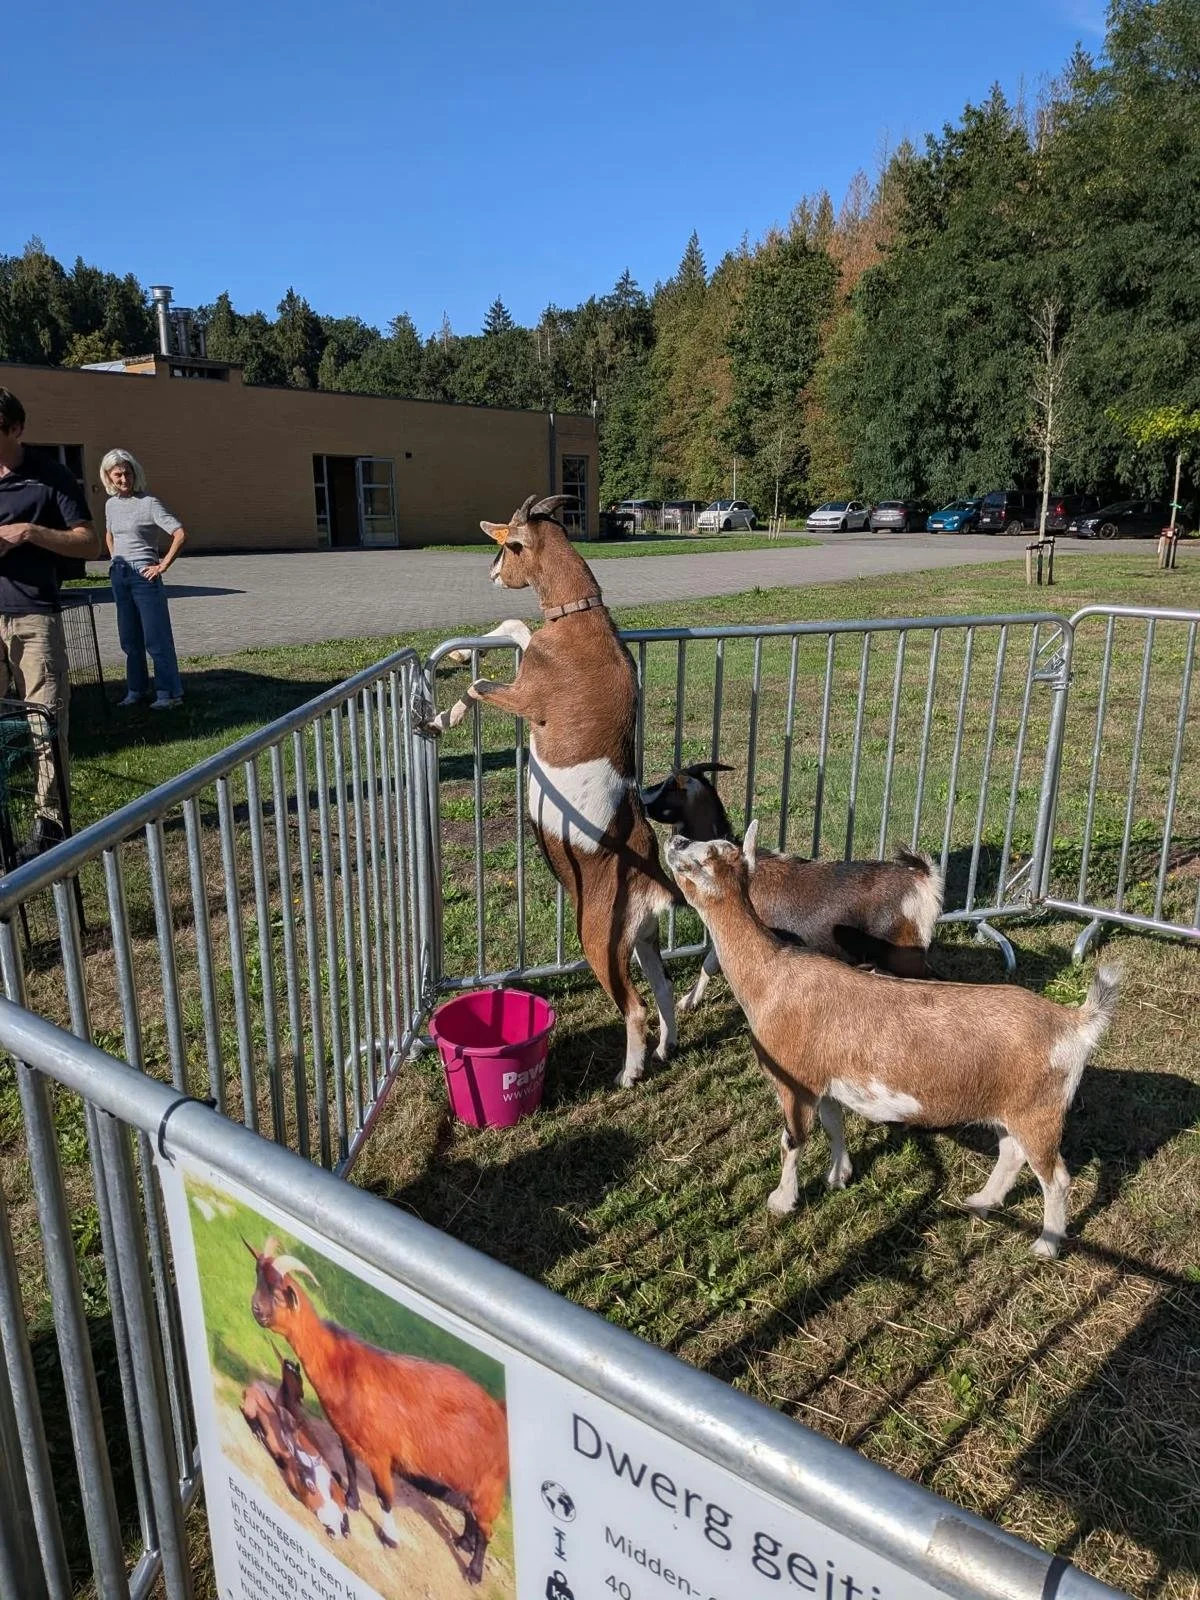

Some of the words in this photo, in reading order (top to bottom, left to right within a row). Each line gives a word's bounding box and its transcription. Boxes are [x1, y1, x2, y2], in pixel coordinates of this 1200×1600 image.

[229, 1477, 247, 1503] Een
[250, 1499, 304, 1557] dwerggeit
[307, 1551, 317, 1568] is
[320, 1566, 342, 1592] een
[231, 1496, 241, 1515] in
[243, 1509, 280, 1553] Europa
[282, 1550, 308, 1579] voor
[572, 1413, 733, 1551] Dwerg
[752, 1532, 881, 1600] geit
[234, 1518, 246, 1538] 50
[249, 1536, 264, 1557] cm
[266, 1550, 298, 1592] hoog)
[239, 1560, 269, 1597] weide
[605, 1526, 701, 1596] Midden-
[605, 1575, 631, 1600] 40
